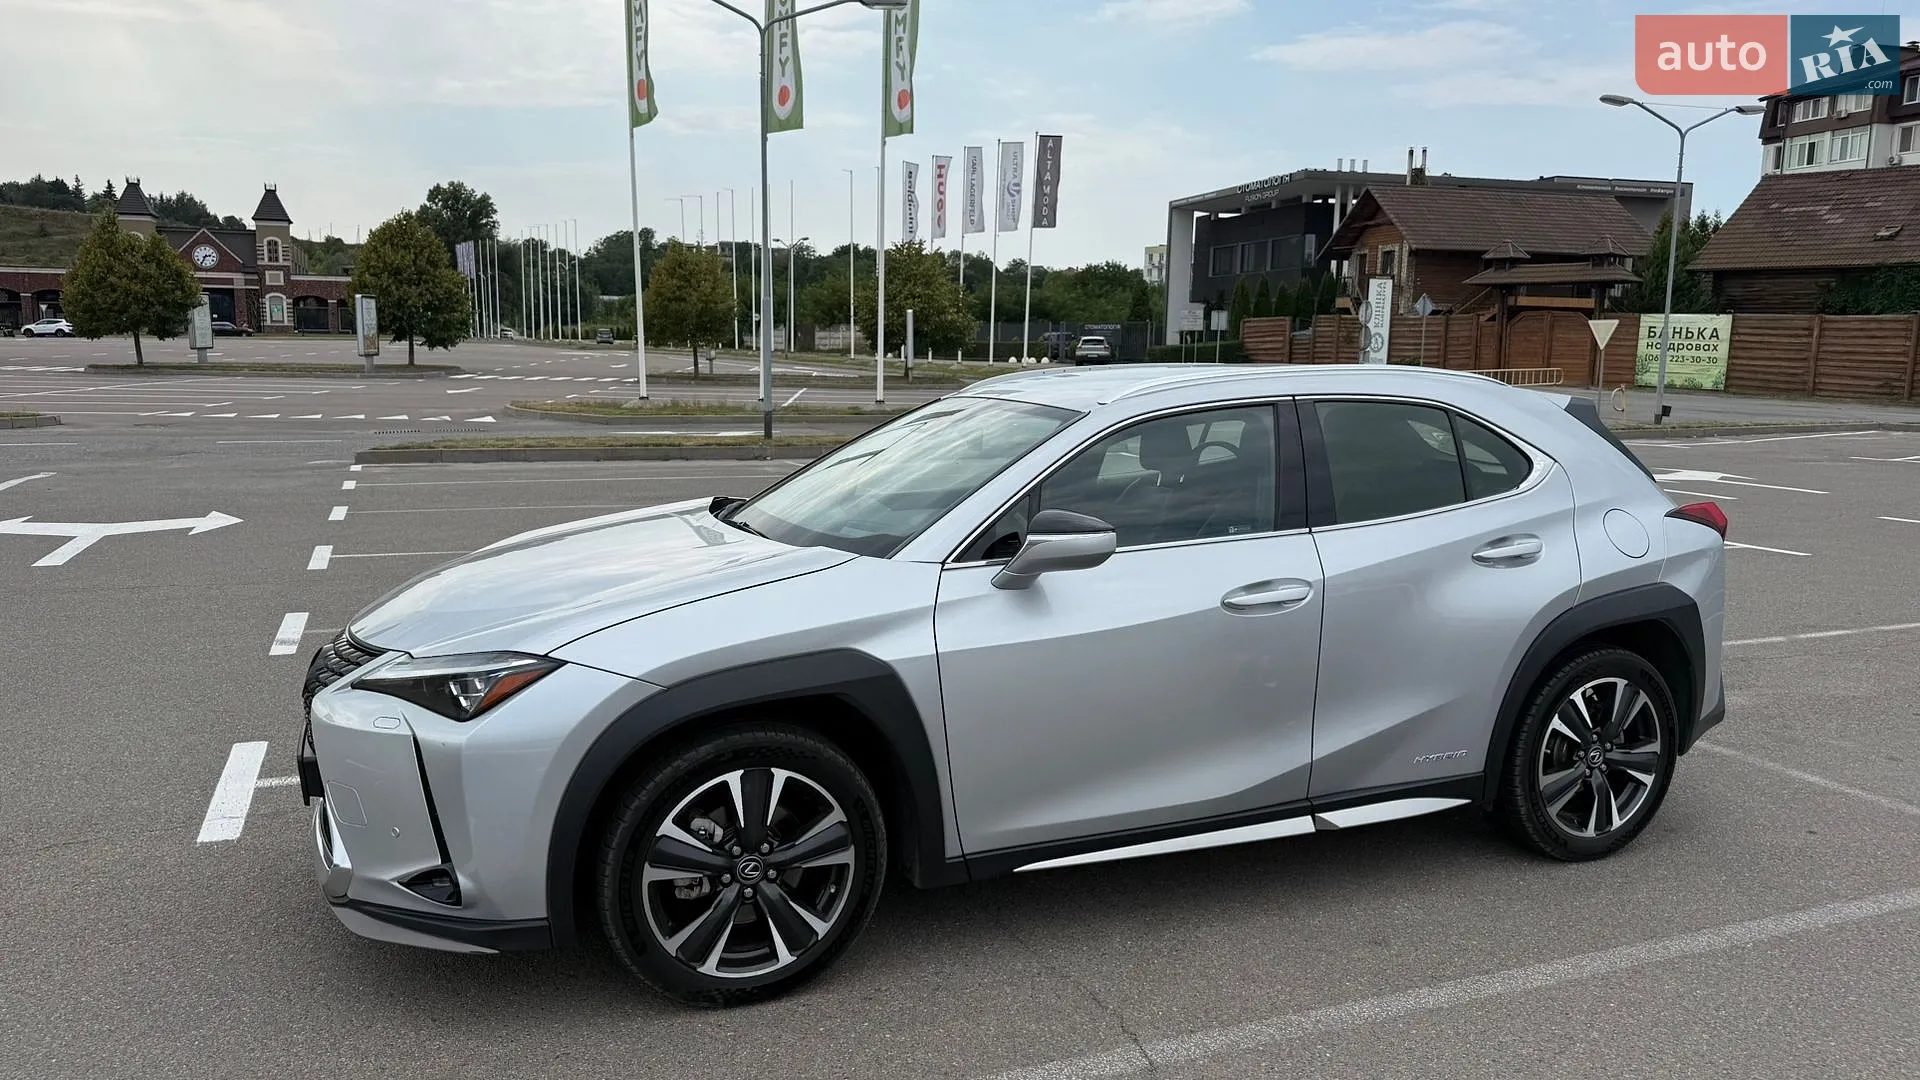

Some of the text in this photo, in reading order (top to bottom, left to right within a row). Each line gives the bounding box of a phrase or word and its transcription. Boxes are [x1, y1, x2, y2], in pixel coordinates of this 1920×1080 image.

[634, 0, 644, 71] MFY
[1041, 138, 1054, 226] ALTAMODA
[1667, 342, 1719, 353] дровах
[1669, 355, 1718, 364] 223-30-30
[1413, 750, 1468, 764] HYBRID
